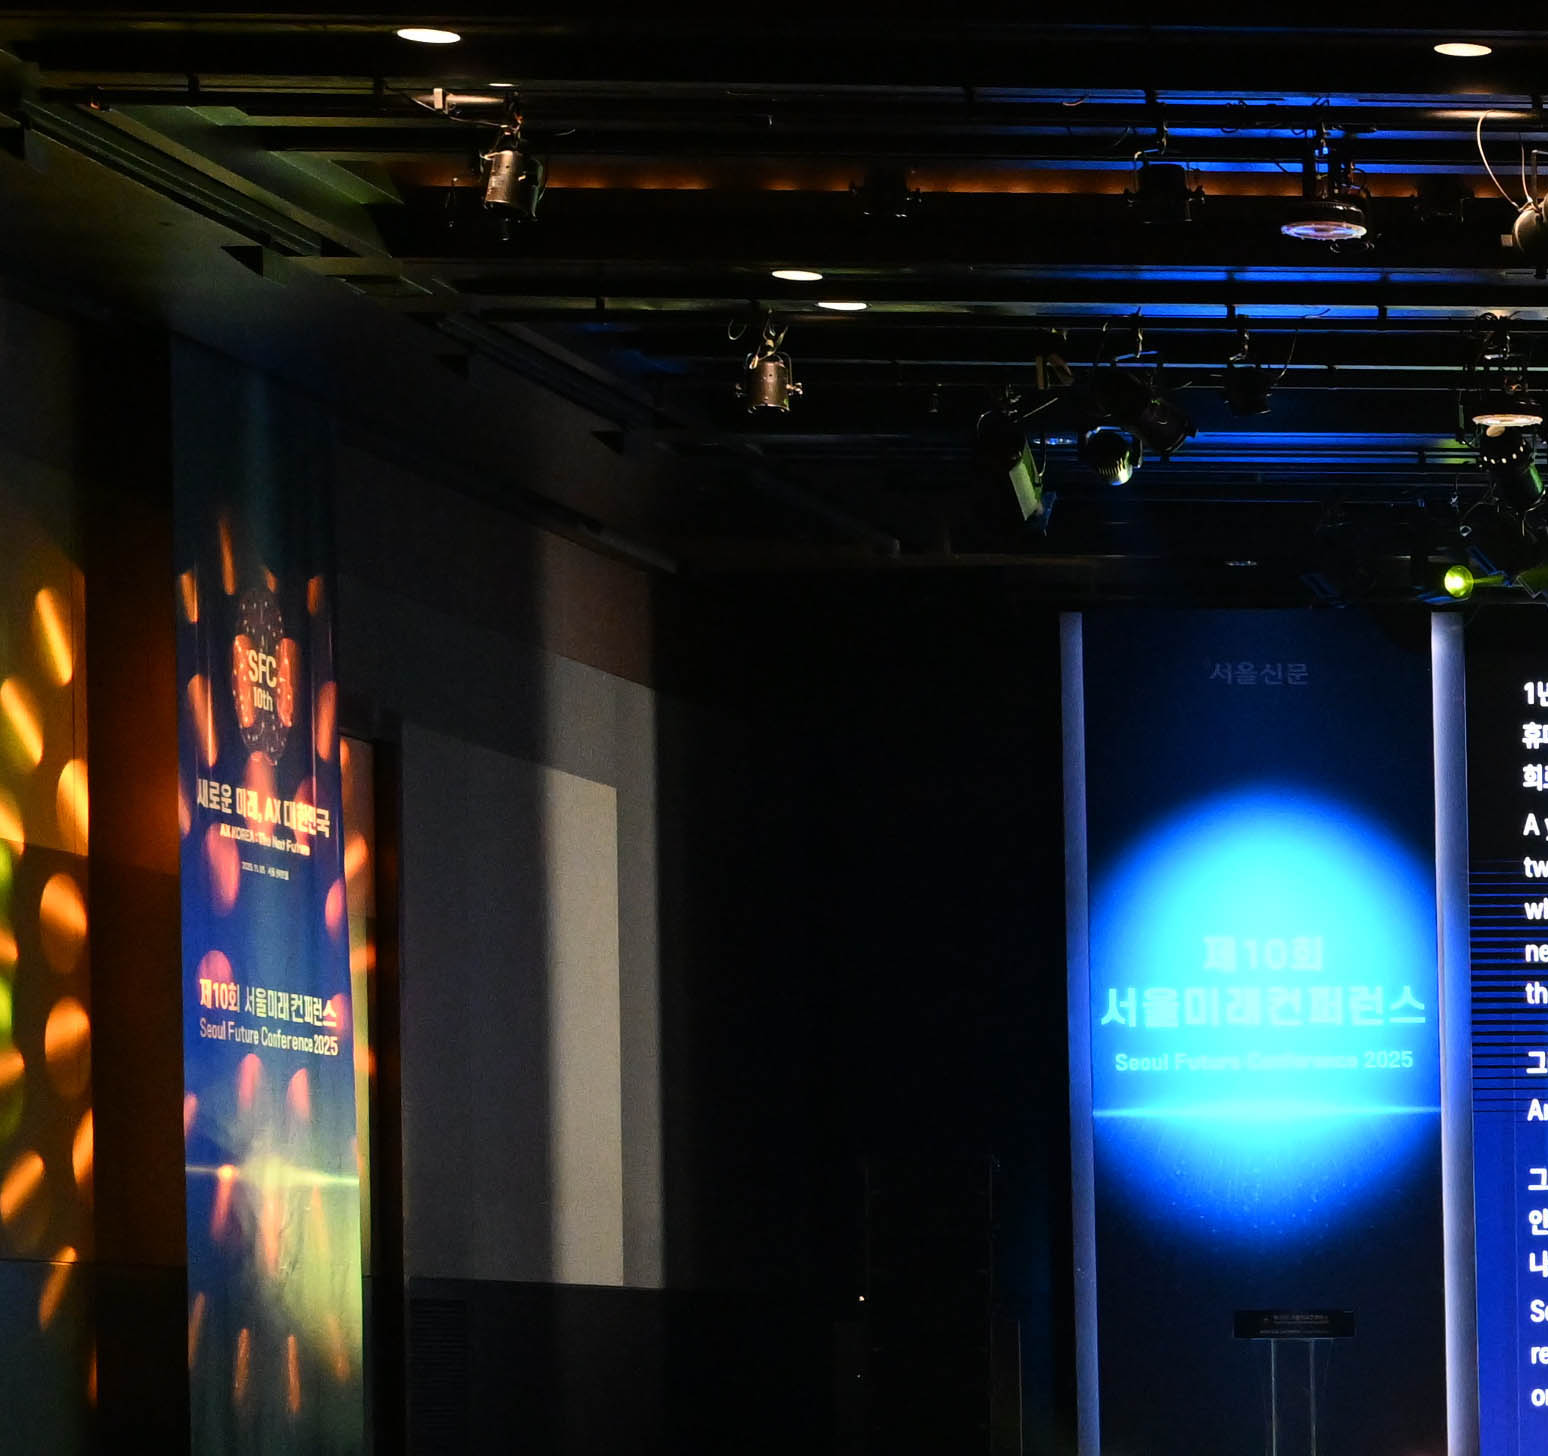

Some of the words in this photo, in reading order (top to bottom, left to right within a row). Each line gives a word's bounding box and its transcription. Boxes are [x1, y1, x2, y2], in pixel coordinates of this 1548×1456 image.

[247, 649, 278, 689] SFC
[1208, 662, 1309, 686] 서울신문
[252, 686, 274, 713] 10th
[196, 777, 233, 815] 새로운
[235, 787, 262, 823] 미래,
[264, 797, 281, 824] AX
[283, 800, 331, 839] 대한민국
[1524, 814, 1540, 835] A
[1202, 933, 1326, 973] 제10회
[200, 978, 240, 1013] 제10회
[245, 986, 337, 1028] 서울미래컨퍼런스
[1100, 984, 1427, 1029] 서울미래컨퍼런스
[200, 1017, 226, 1041] Seoul
[228, 1020, 260, 1045] Future
[261, 1026, 313, 1052] Conference
[314, 1034, 339, 1056] 2025
[1114, 1052, 1169, 1072] Seoul
[1364, 1050, 1414, 1069] 2025
